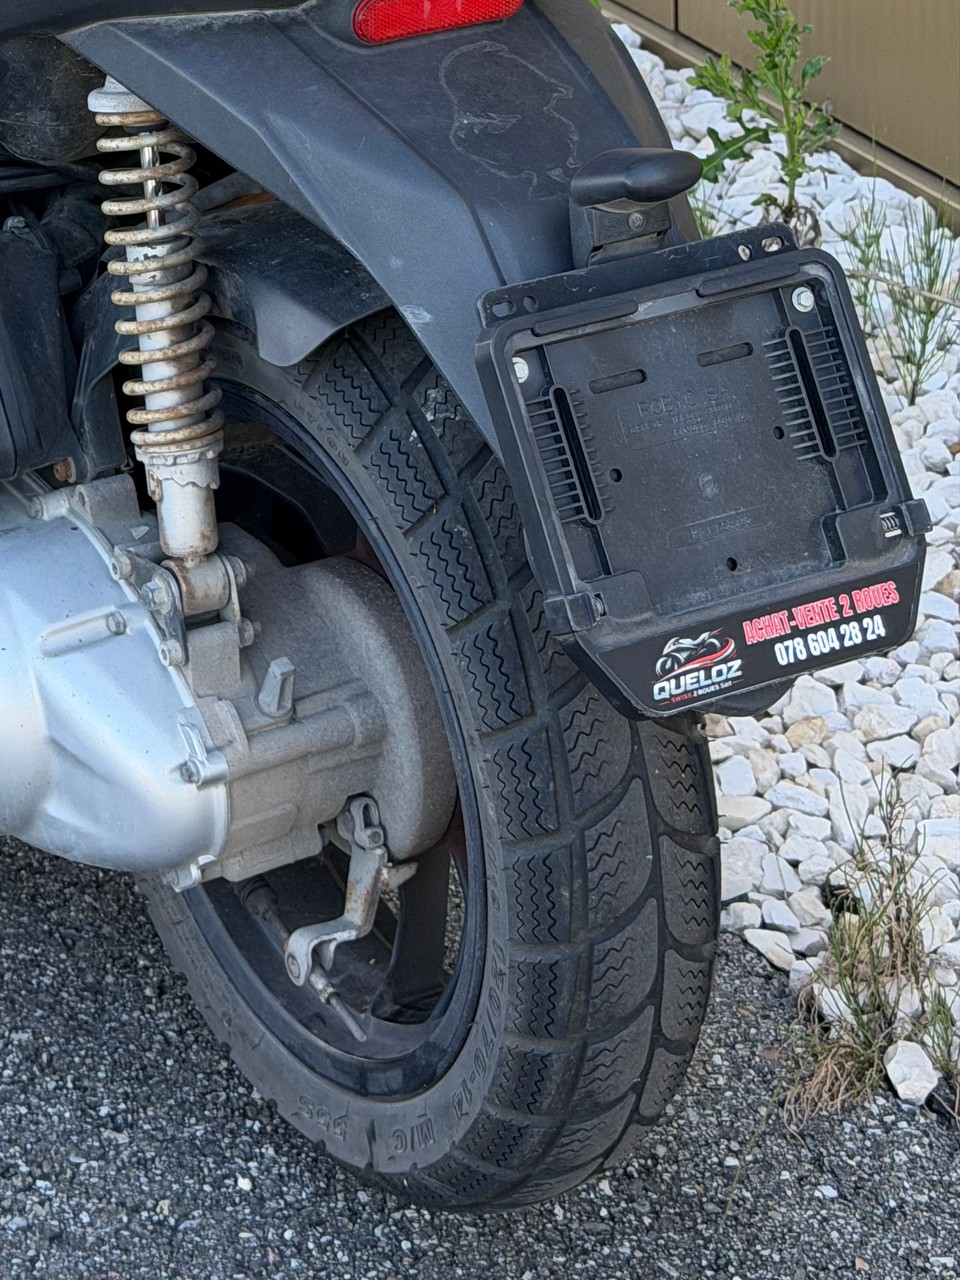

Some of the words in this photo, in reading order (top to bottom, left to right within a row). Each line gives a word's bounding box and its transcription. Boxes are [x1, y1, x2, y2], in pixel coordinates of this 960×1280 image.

[742, 597, 839, 645] ACHAT-VENTE
[839, 594, 854, 617] 2
[851, 580, 900, 613] ROUES
[774, 637, 807, 666] 078
[807, 628, 840, 656] 604
[840, 621, 862, 647] 28
[863, 614, 886, 641] 24
[653, 659, 742, 700] QUELOZ
[698, 684, 720, 696] ROUES
[393, 1117, 436, 1154] M/C
